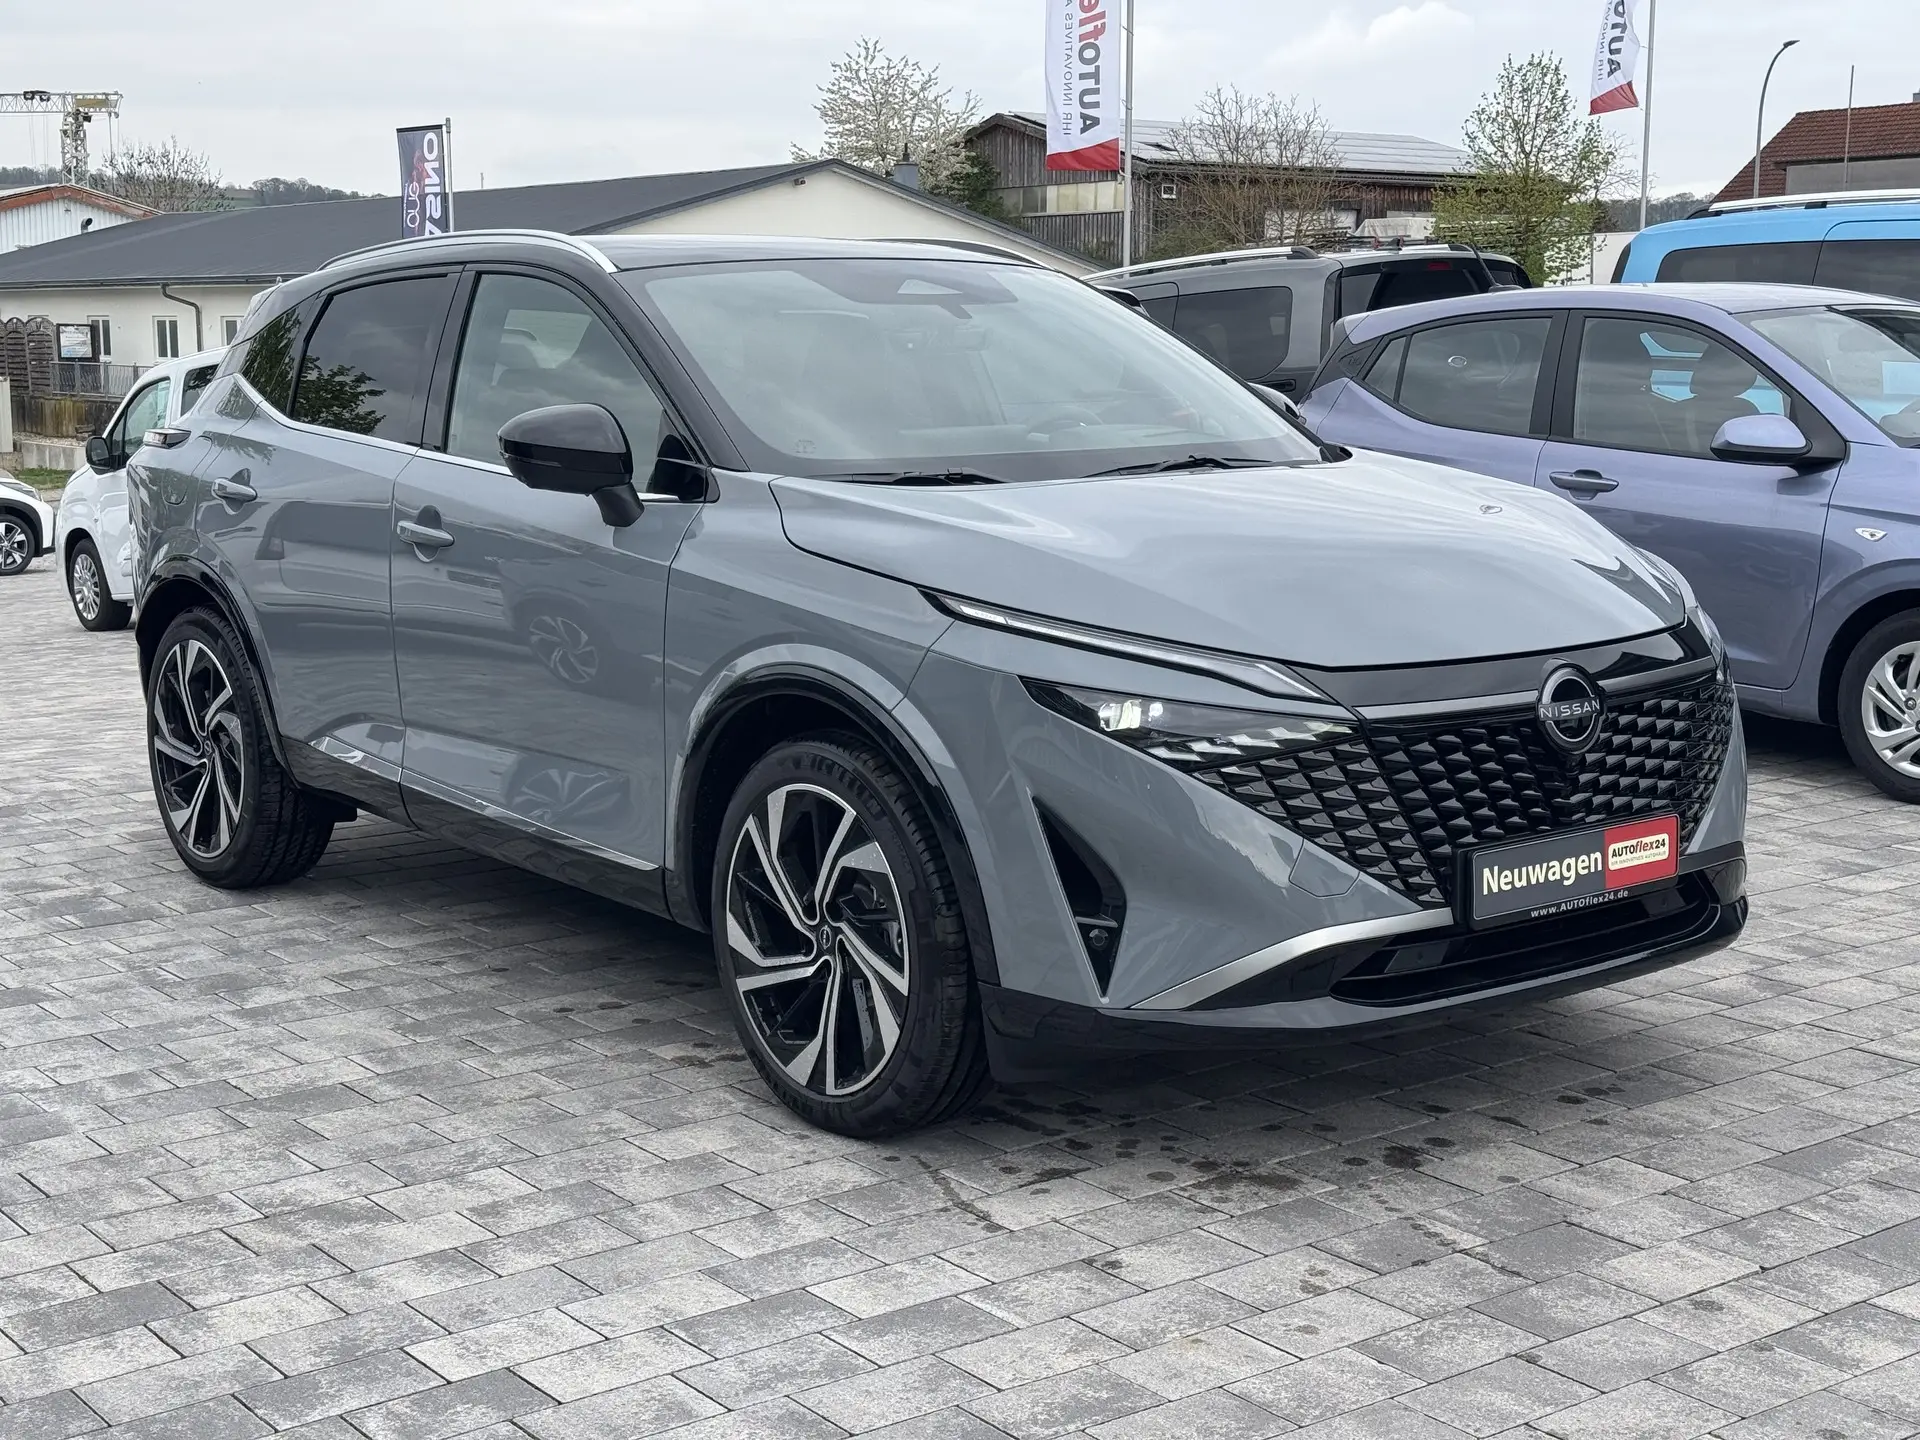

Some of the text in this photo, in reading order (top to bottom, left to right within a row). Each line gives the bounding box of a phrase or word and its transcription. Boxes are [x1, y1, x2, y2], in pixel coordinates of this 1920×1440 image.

[1540, 699, 1600, 719] NISSAN
[1611, 838, 1666, 859] AUTOflex24
[1482, 851, 1603, 895] Neuwagen
[1530, 889, 1629, 918] www.AUTOflex24.de
